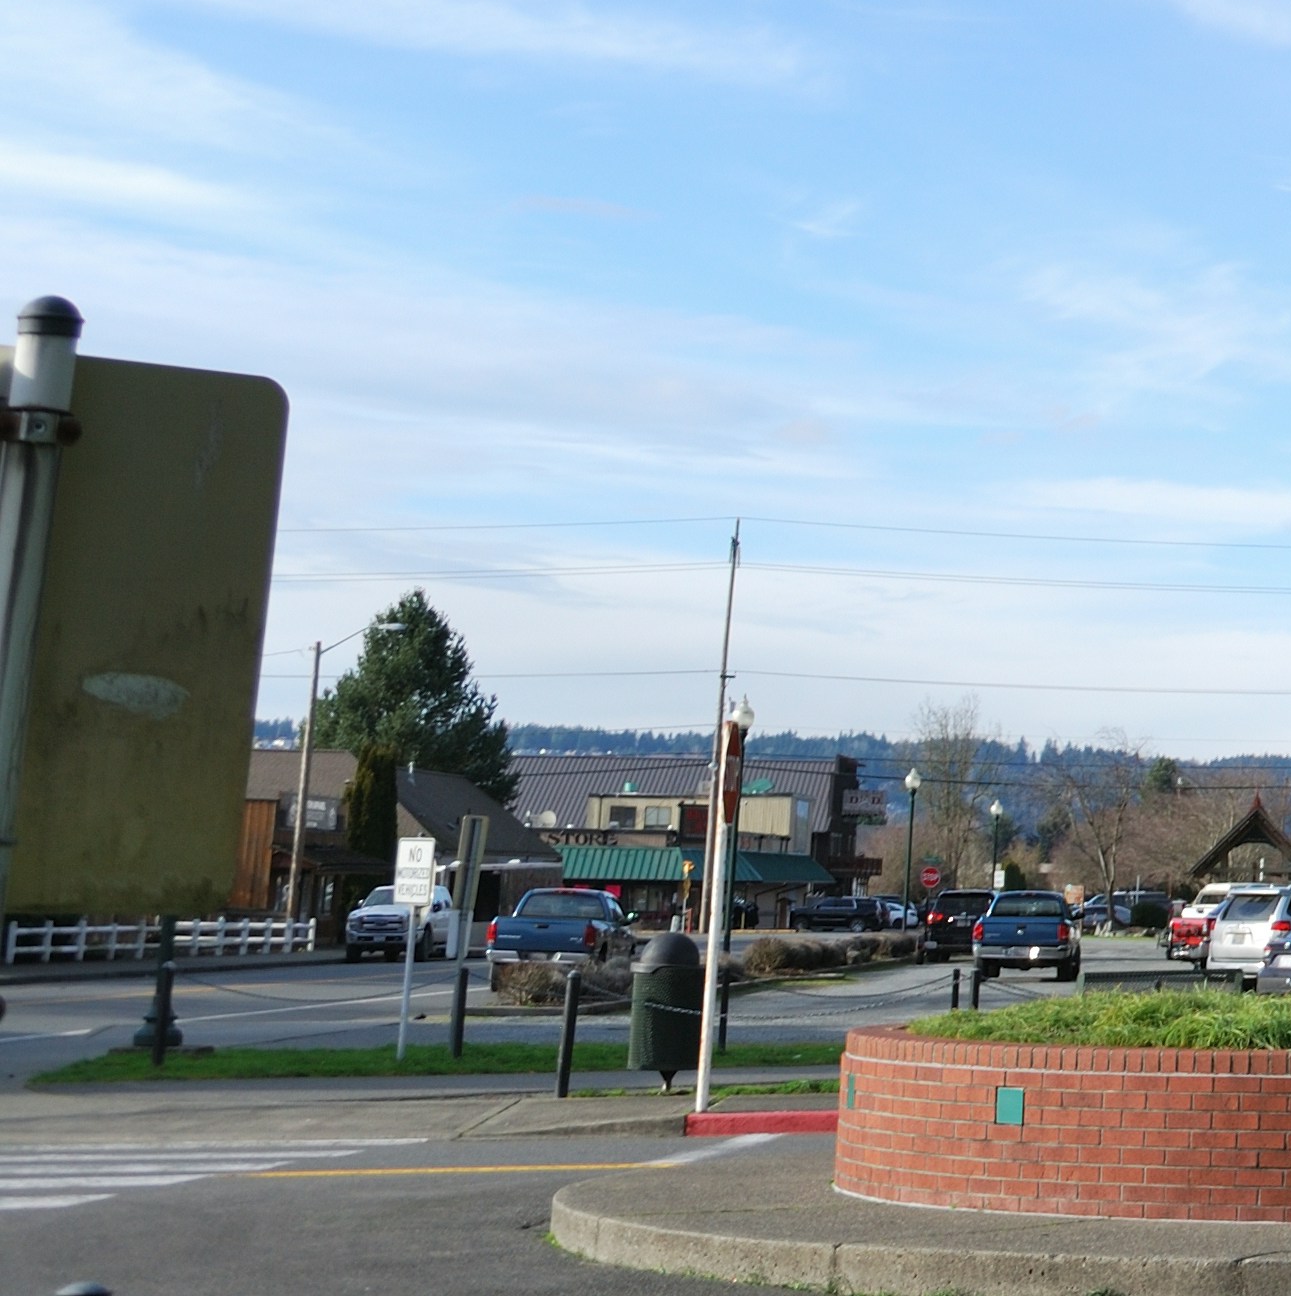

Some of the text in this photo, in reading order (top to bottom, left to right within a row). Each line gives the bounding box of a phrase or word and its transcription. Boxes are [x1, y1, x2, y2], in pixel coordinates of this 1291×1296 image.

[548, 831, 618, 846] STORE
[408, 847, 423, 863] NO
[397, 867, 430, 879] MOTORIZED
[397, 884, 428, 897] VEHICLES
